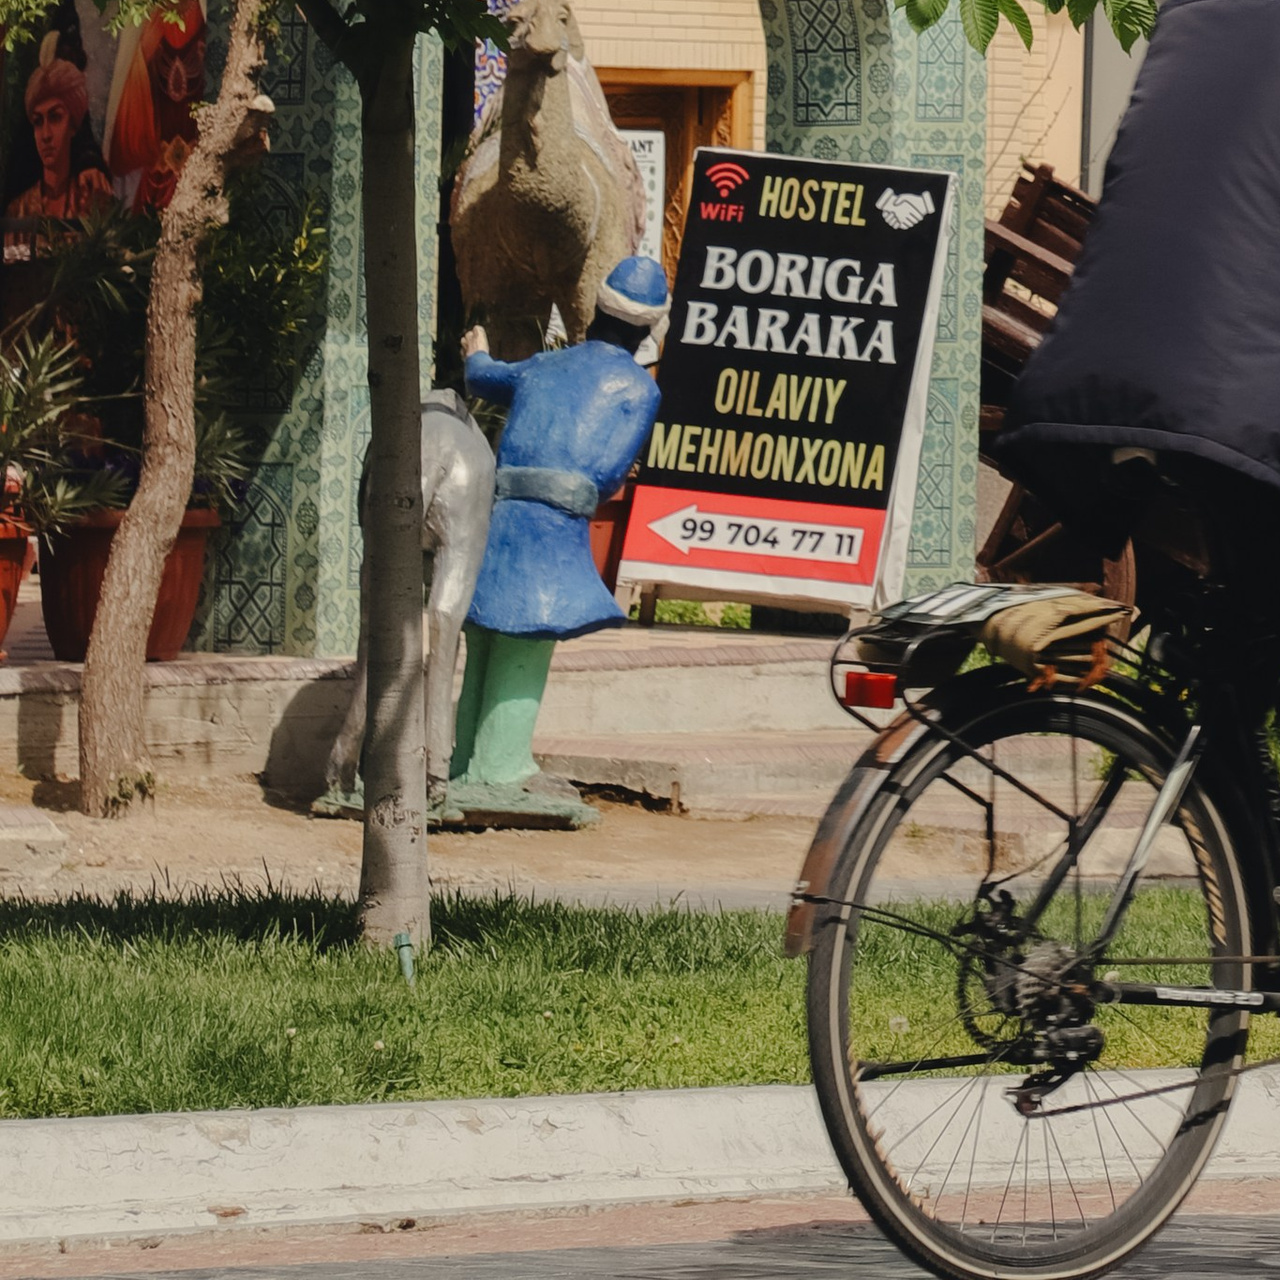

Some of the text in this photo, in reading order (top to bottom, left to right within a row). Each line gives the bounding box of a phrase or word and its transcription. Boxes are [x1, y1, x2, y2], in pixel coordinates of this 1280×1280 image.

[700, 202, 744, 224] WiFi
[759, 176, 866, 226] HOSTEL
[700, 245, 898, 307] BORIGA
[680, 301, 897, 364] BARAKA
[714, 367, 847, 425] OILAVIY
[647, 422, 885, 491] MEHMONXONA
[681, 517, 856, 556] 99 704 77 11
